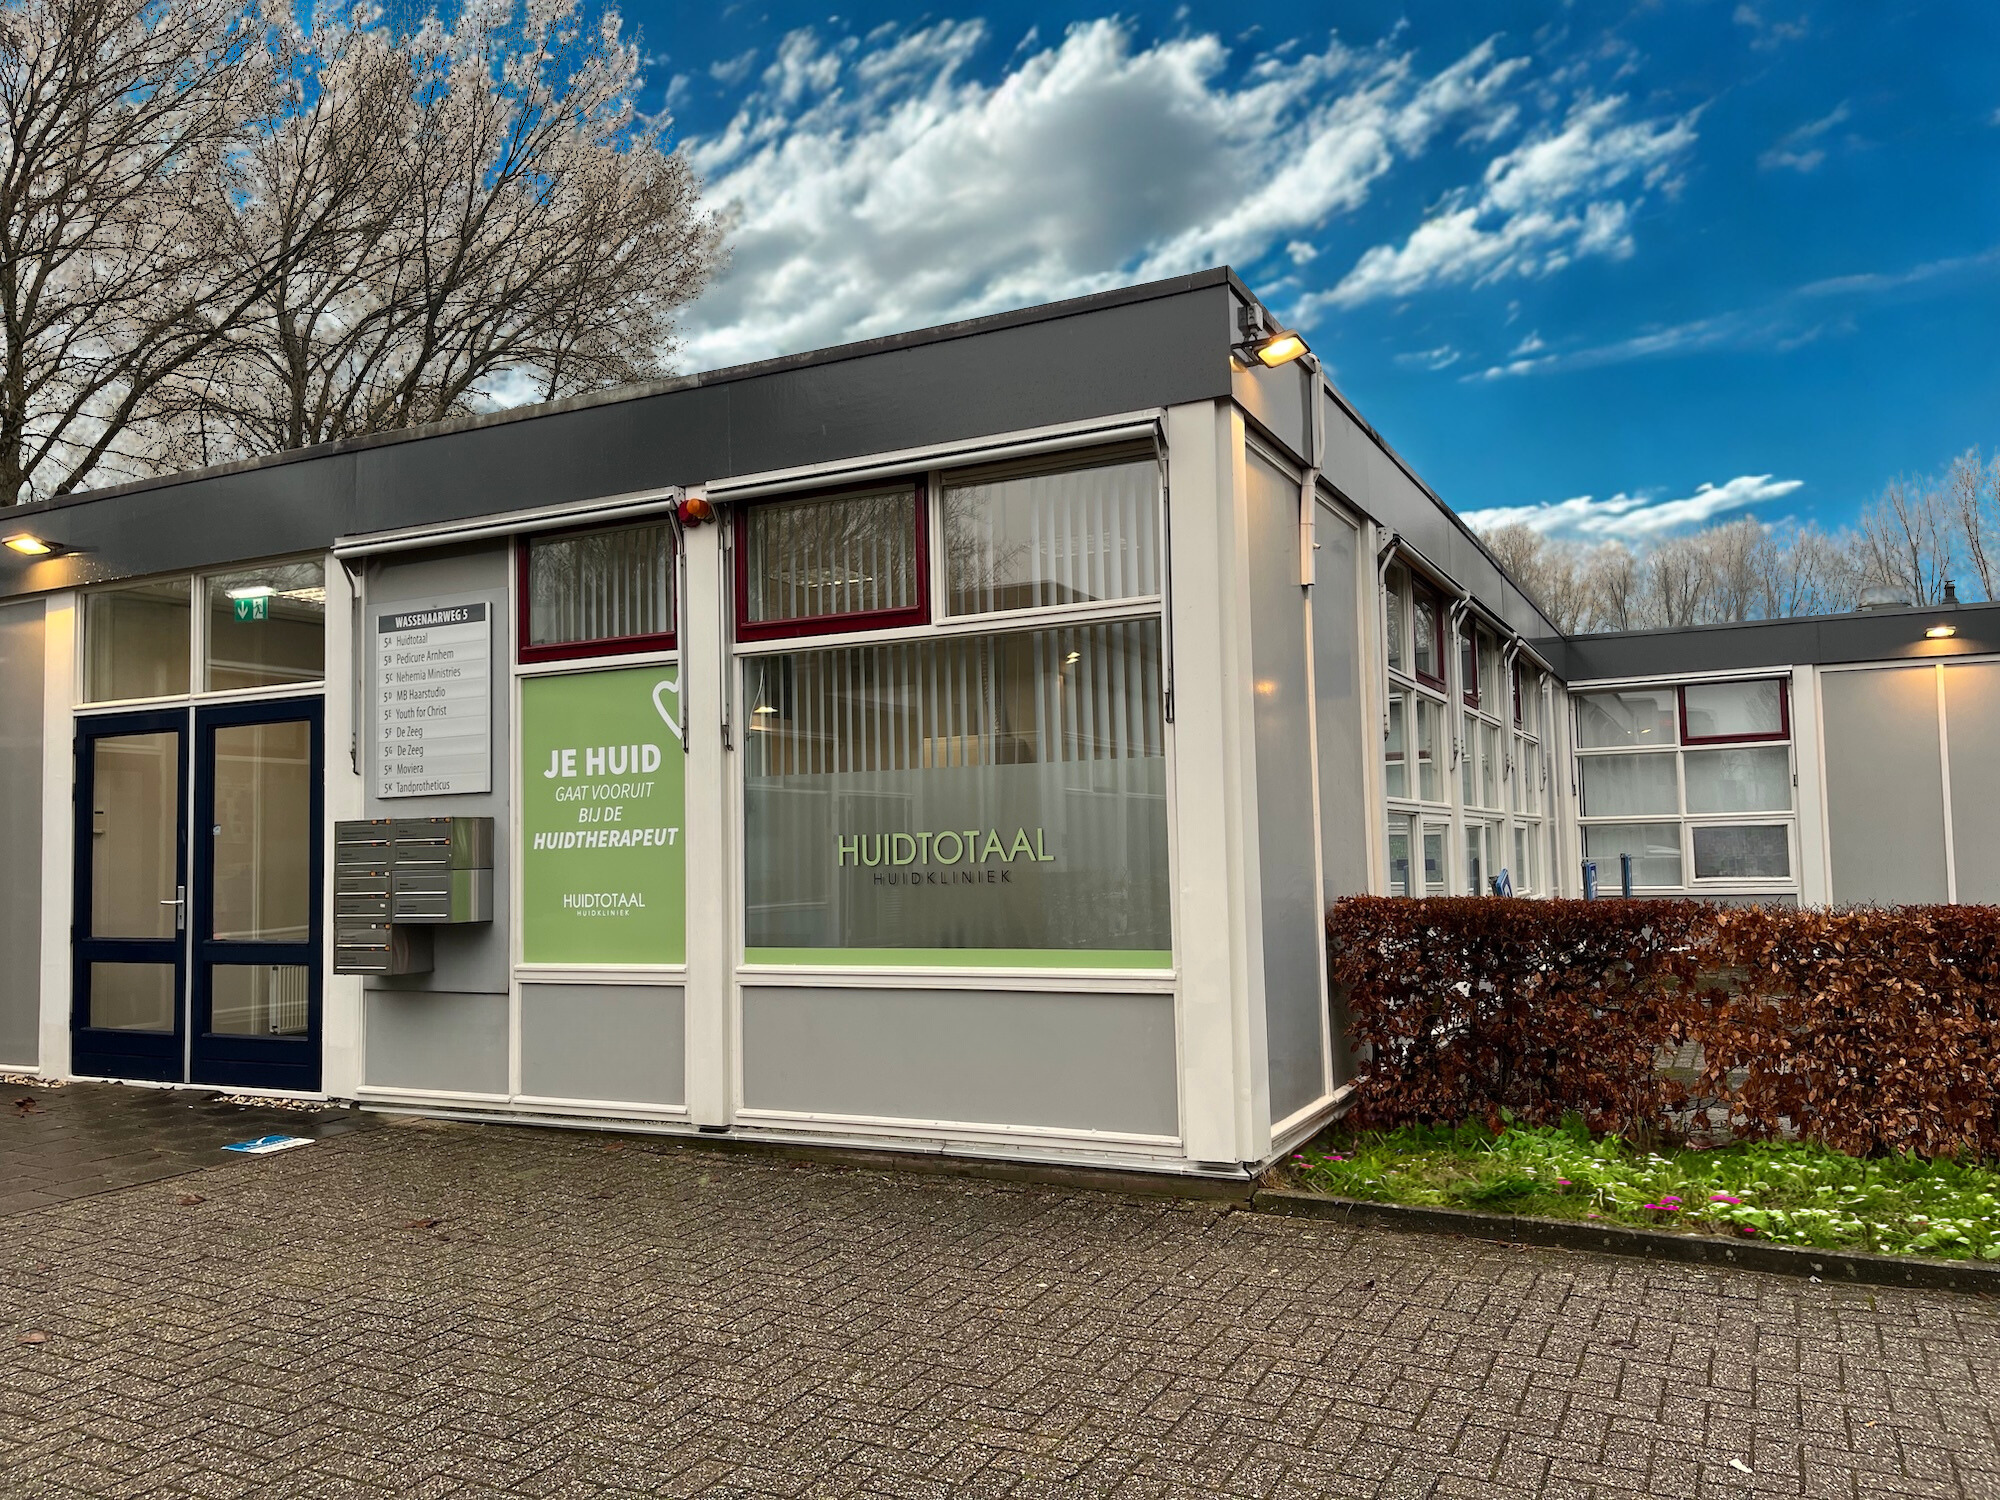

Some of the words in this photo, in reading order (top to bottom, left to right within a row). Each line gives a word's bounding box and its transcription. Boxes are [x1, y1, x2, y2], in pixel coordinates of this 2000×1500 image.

[395, 609, 461, 628] WASSENAARWEG
[462, 608, 469, 620] 5
[396, 632, 428, 647] Huidtotaal
[396, 652, 425, 665] Pedicure
[426, 648, 454, 661] Arnhem
[396, 670, 426, 683] Nehemia
[427, 666, 461, 680] Ministries
[396, 690, 408, 701] MB
[409, 686, 446, 700] Haarstudio
[395, 707, 415, 719] Youth
[416, 706, 426, 717] for
[427, 705, 447, 717] Christ
[396, 726, 406, 738] De
[407, 725, 423, 739] Zeeg
[397, 745, 407, 756] De
[407, 744, 424, 757] Zeeg
[396, 763, 424, 775] Moviera
[543, 748, 577, 779] JE
[585, 743, 662, 777] HUID
[396, 779, 450, 794] Tandprotheticus
[555, 785, 589, 802] GAAT
[592, 782, 655, 801] VOORUIT
[578, 807, 601, 823] BIJ
[603, 806, 623, 822] DE
[533, 827, 679, 850] HUIDTHERAPEUT
[838, 826, 1055, 867] HUIDTOTAAL
[873, 869, 1012, 886] HUIDKLINIEK
[563, 892, 646, 908] HUIDTOTAAL
[576, 909, 630, 917] HUIDKLINIEK
